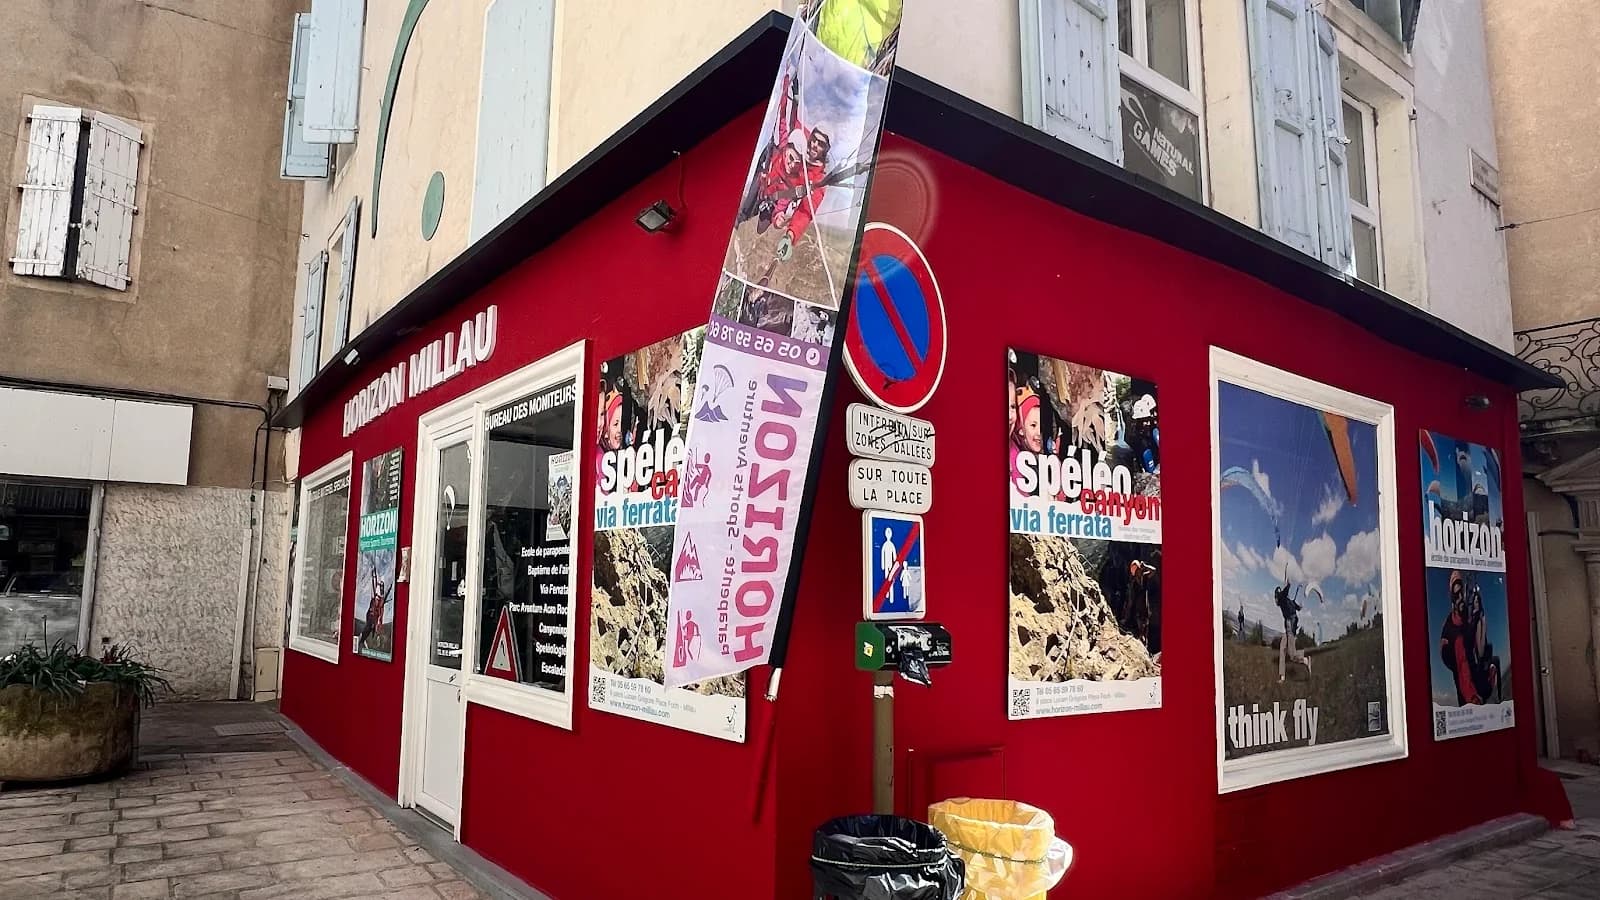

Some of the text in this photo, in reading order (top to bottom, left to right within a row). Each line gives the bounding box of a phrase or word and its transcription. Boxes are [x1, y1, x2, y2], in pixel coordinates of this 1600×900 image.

[1133, 120, 1177, 177] GAMES
[343, 305, 498, 438] HORIZON MILLAU
[485, 383, 577, 431] BUREAU DES MONITEURS
[856, 432, 932, 460] ZONES DALLEES
[913, 425, 930, 440] SUR
[600, 423, 686, 494] spélé
[1015, 445, 1132, 500] spéléo
[857, 467, 928, 486] SUR TOUTE
[863, 487, 923, 505] LA PLACE
[1080, 488, 1160, 526] canyon
[360, 510, 396, 538] HORIZON
[597, 501, 617, 529] via
[1011, 503, 1041, 532] via
[1048, 505, 1112, 538] ferrata
[1428, 500, 1502, 559] horizon
[536, 546, 542, 556] de
[551, 564, 558, 575] de
[540, 583, 548, 594] Via
[509, 602, 520, 612] Parc
[1228, 699, 1319, 749] think fly
